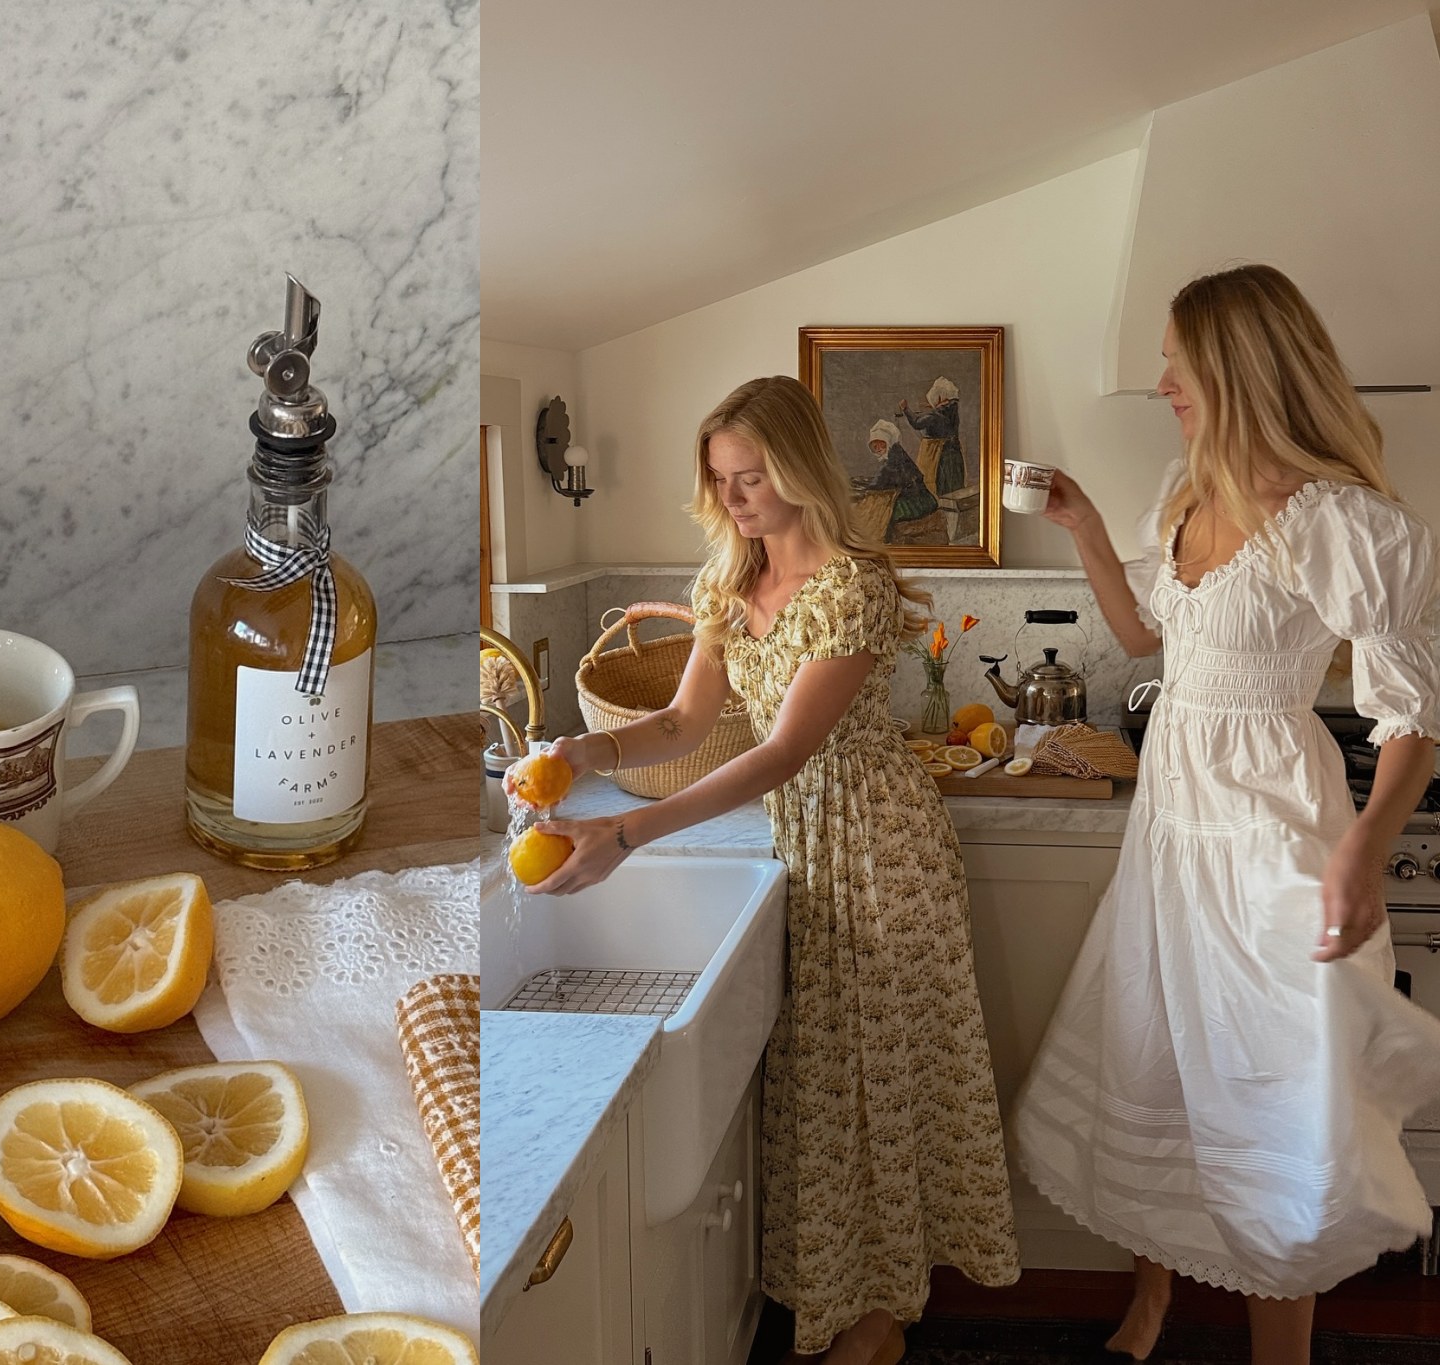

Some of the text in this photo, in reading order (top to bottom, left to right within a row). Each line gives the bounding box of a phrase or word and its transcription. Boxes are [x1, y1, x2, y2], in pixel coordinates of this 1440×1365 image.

[281, 707, 341, 725] OLIVE
[255, 735, 357, 760] LAVENDER
[278, 770, 338, 793] FARMS
